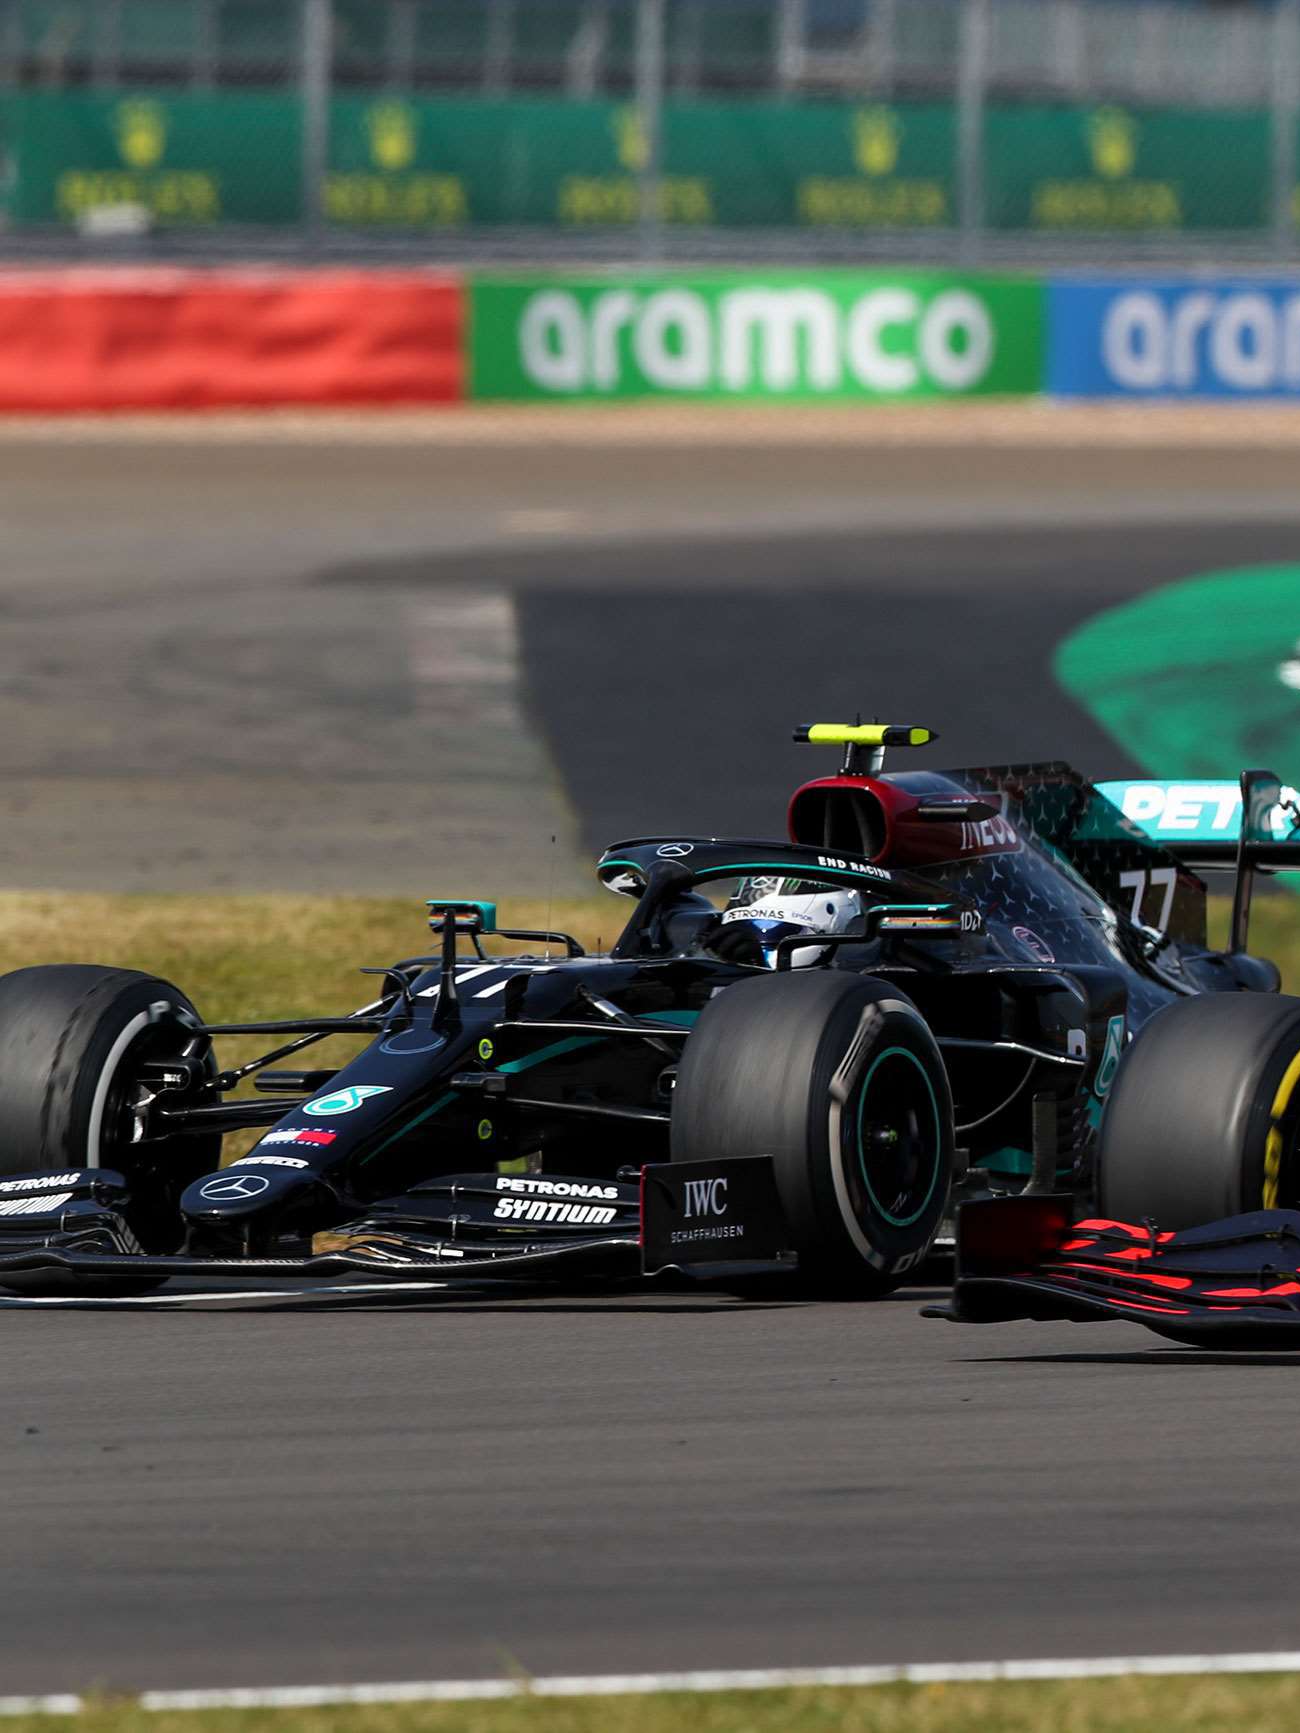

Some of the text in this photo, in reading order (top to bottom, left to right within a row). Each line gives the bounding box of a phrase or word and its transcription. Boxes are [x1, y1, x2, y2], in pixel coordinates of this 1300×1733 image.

[520, 289, 994, 391] aramco
[818, 856, 891, 881] END RACISM
[727, 908, 785, 920] PETRONAS
[1119, 867, 1177, 935] 77
[496, 1178, 618, 1200] PETRONAS
[683, 1178, 728, 1218] IWC
[493, 1198, 617, 1225] SYNTIUM
[671, 1225, 744, 1244] SCHAFFHAUSEN
